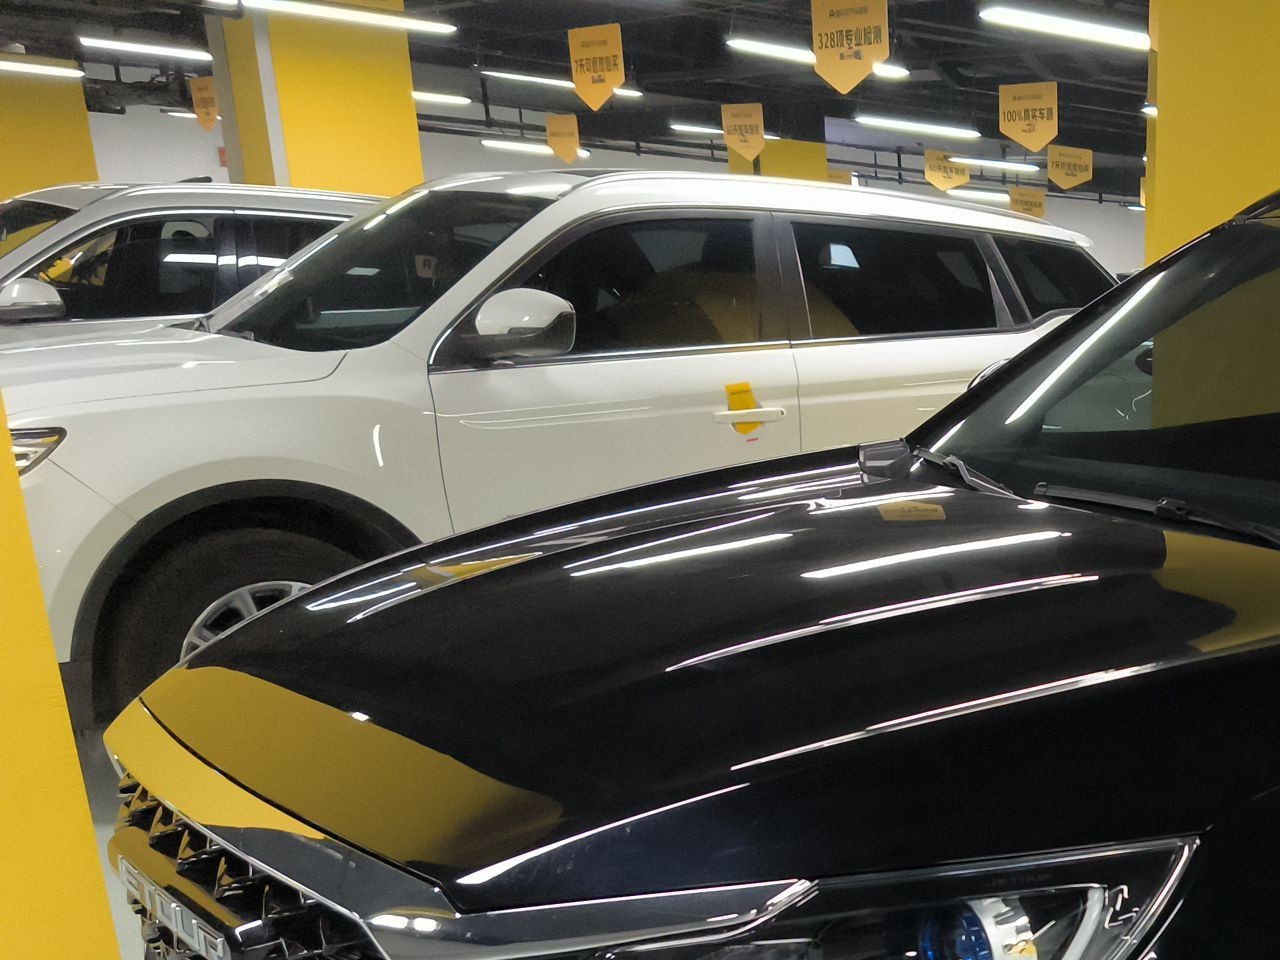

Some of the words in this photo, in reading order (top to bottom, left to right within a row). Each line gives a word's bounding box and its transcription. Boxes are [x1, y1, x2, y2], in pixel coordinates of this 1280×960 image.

[817, 25, 882, 50] 328项专业检测
